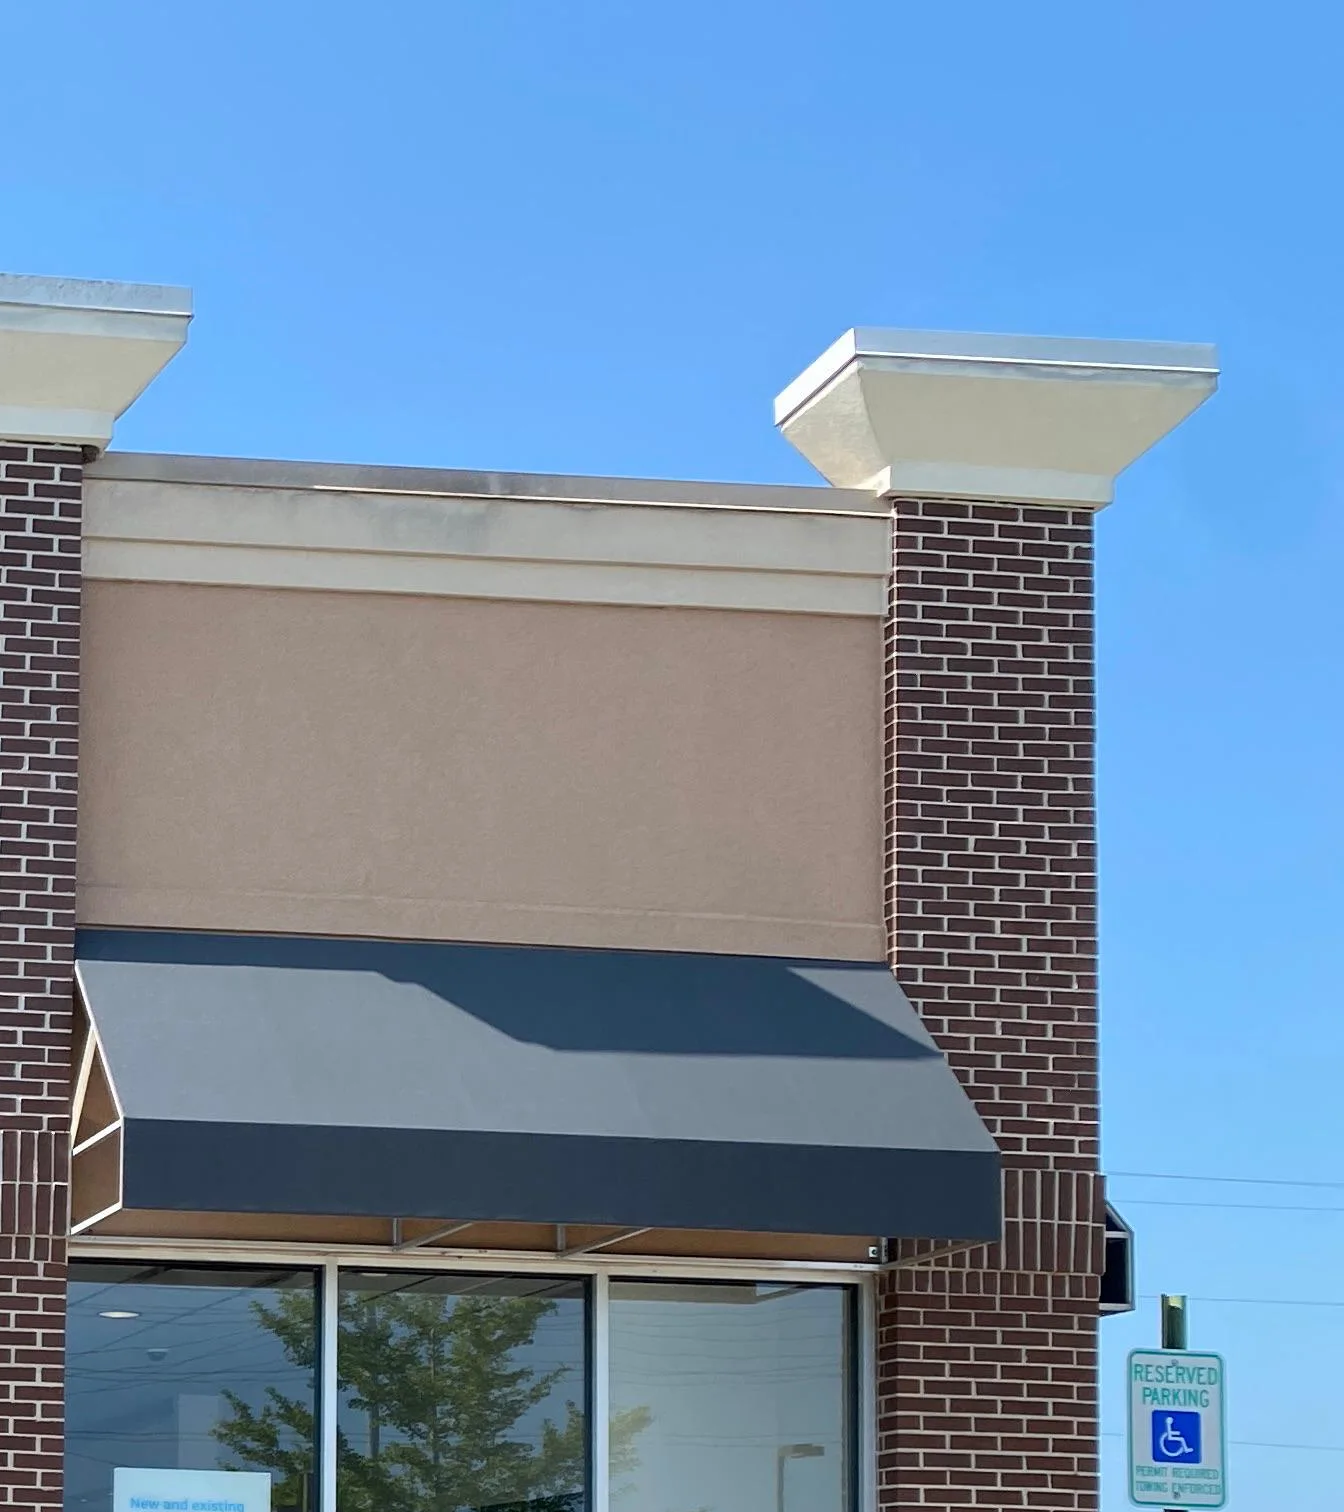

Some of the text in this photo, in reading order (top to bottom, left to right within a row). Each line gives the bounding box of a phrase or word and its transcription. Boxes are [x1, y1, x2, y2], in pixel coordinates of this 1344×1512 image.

[1134, 1364, 1218, 1385] RESERVED
[1142, 1387, 1209, 1408] PARKING
[1135, 1465, 1219, 1480] PERMIT REQUIRED
[130, 1498, 159, 1509] New
[163, 1499, 188, 1510] and
